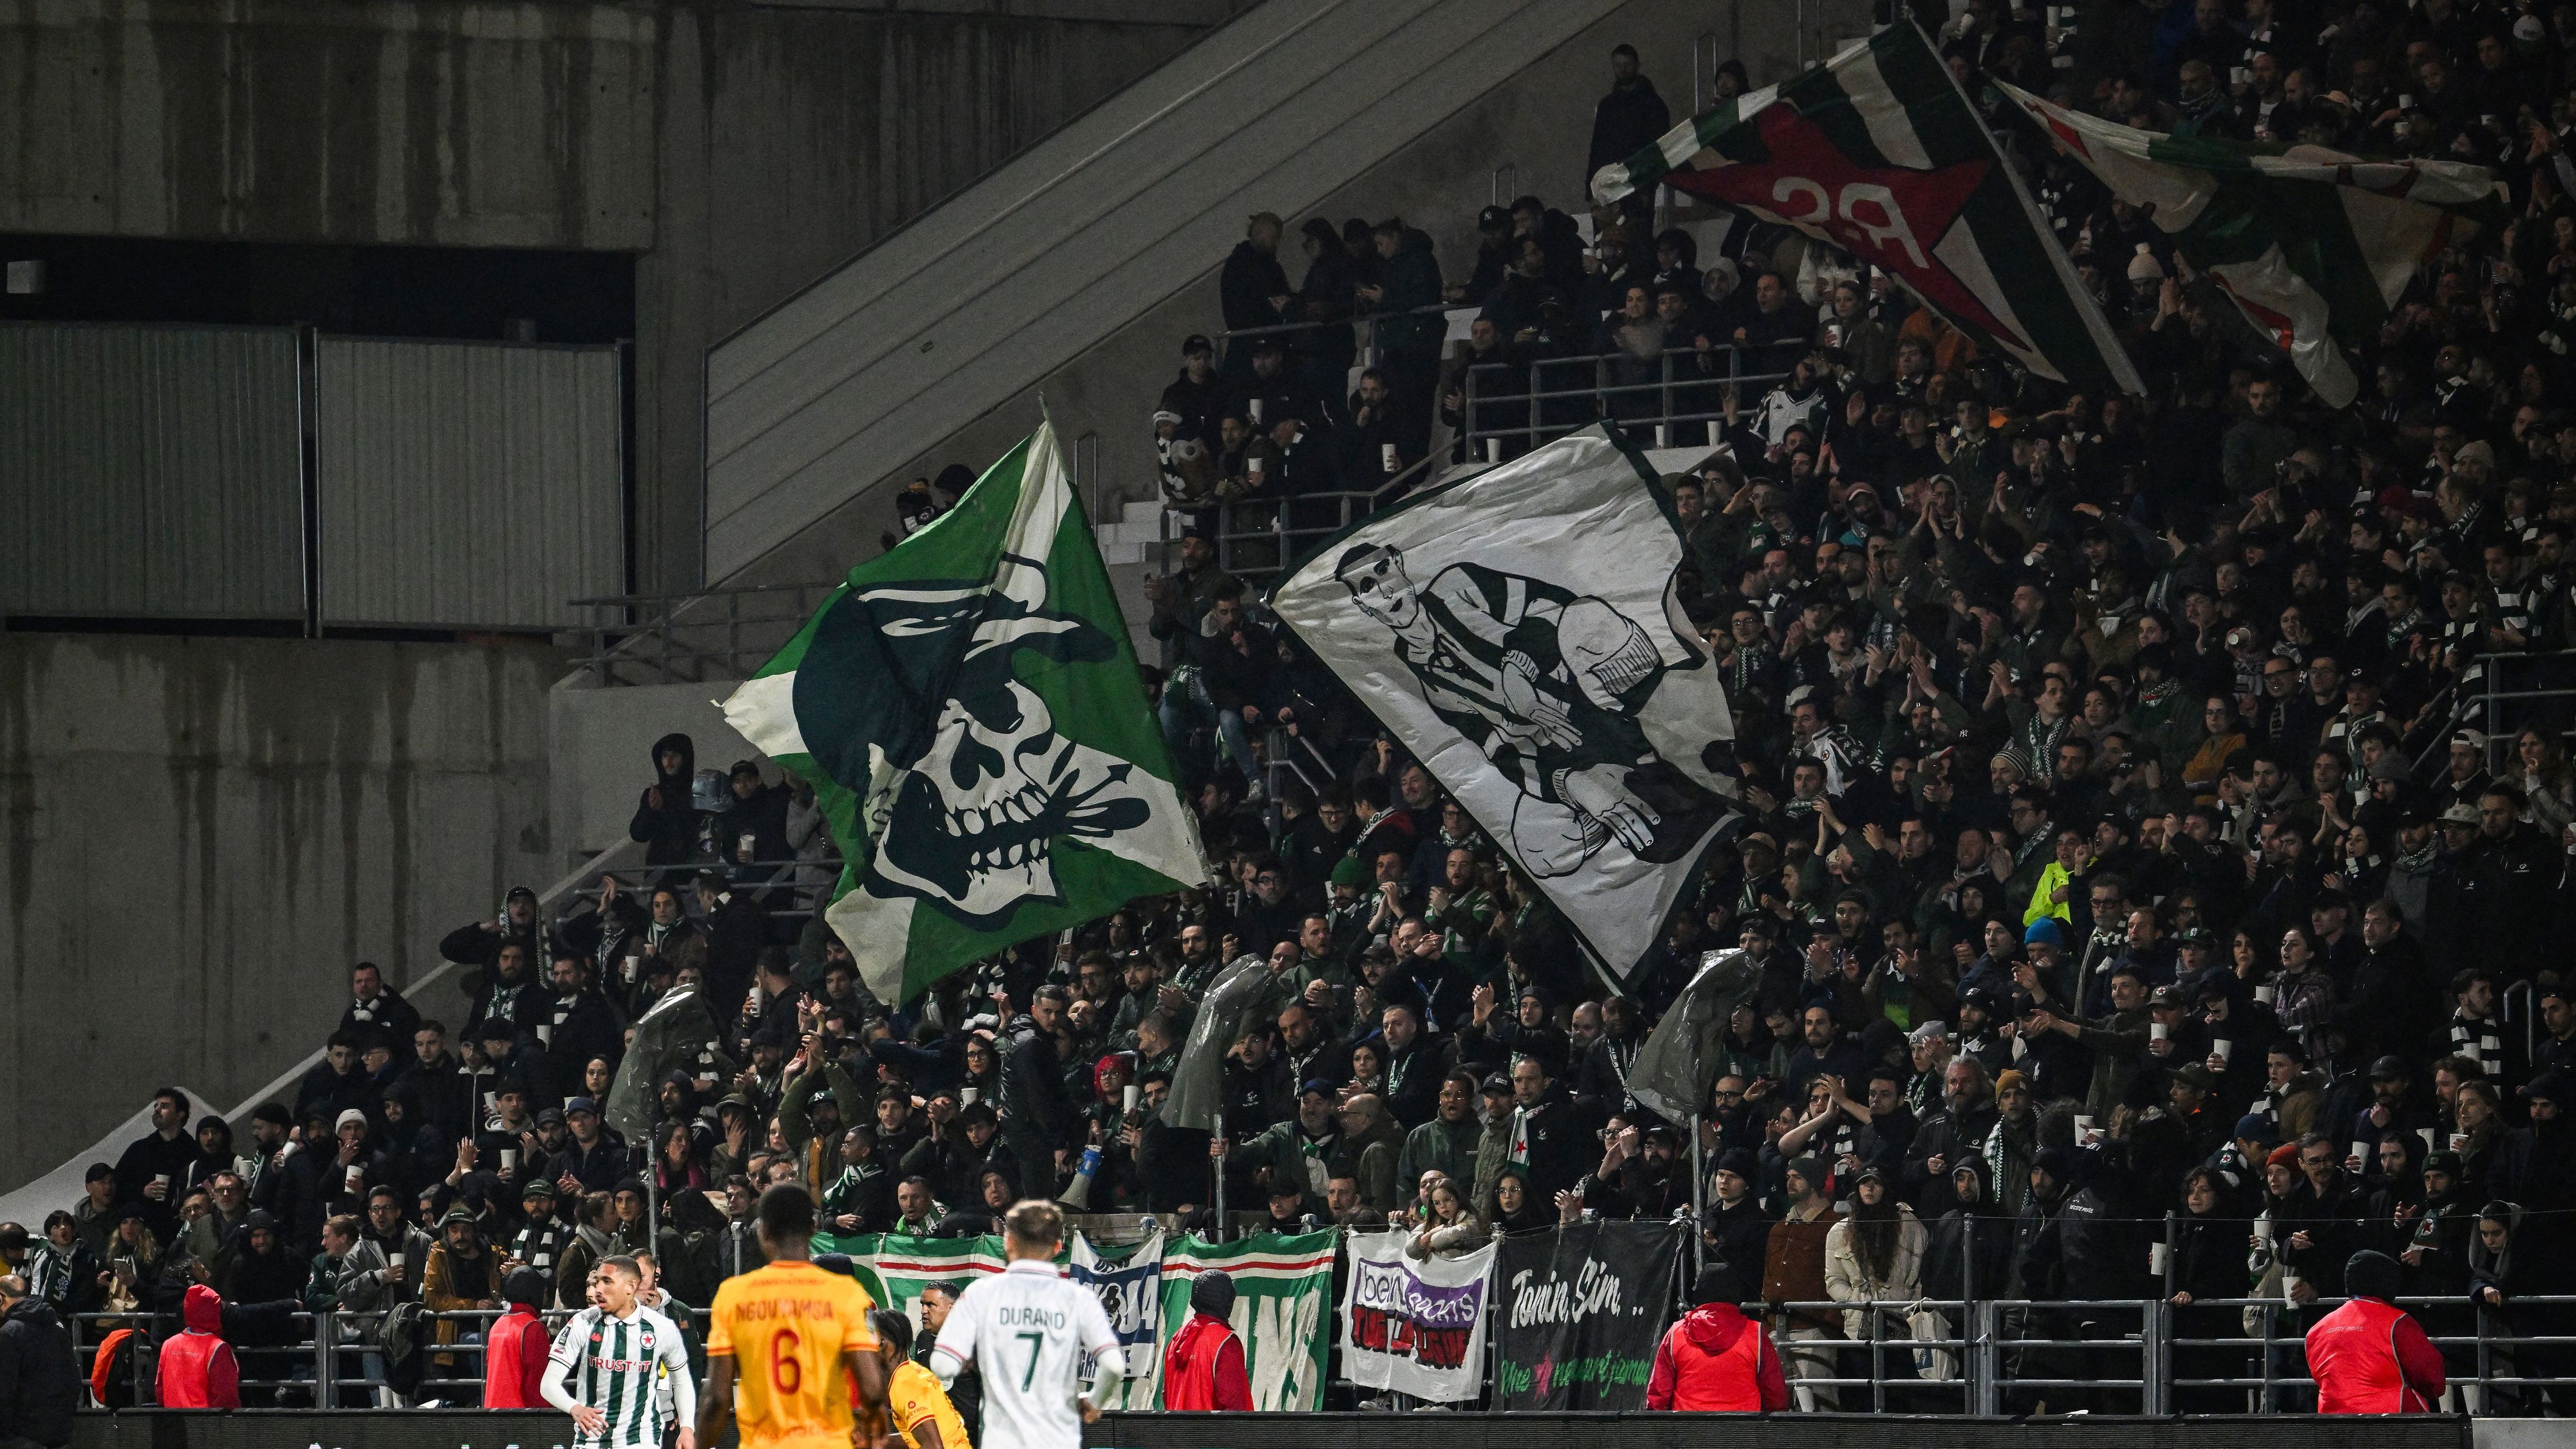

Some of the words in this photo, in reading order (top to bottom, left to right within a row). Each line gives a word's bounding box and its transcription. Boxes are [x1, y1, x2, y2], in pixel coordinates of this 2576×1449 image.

[1000, 1307, 1066, 1330] DURAND
[772, 1329, 800, 1394] 6
[1015, 1331, 1043, 1393] 7
